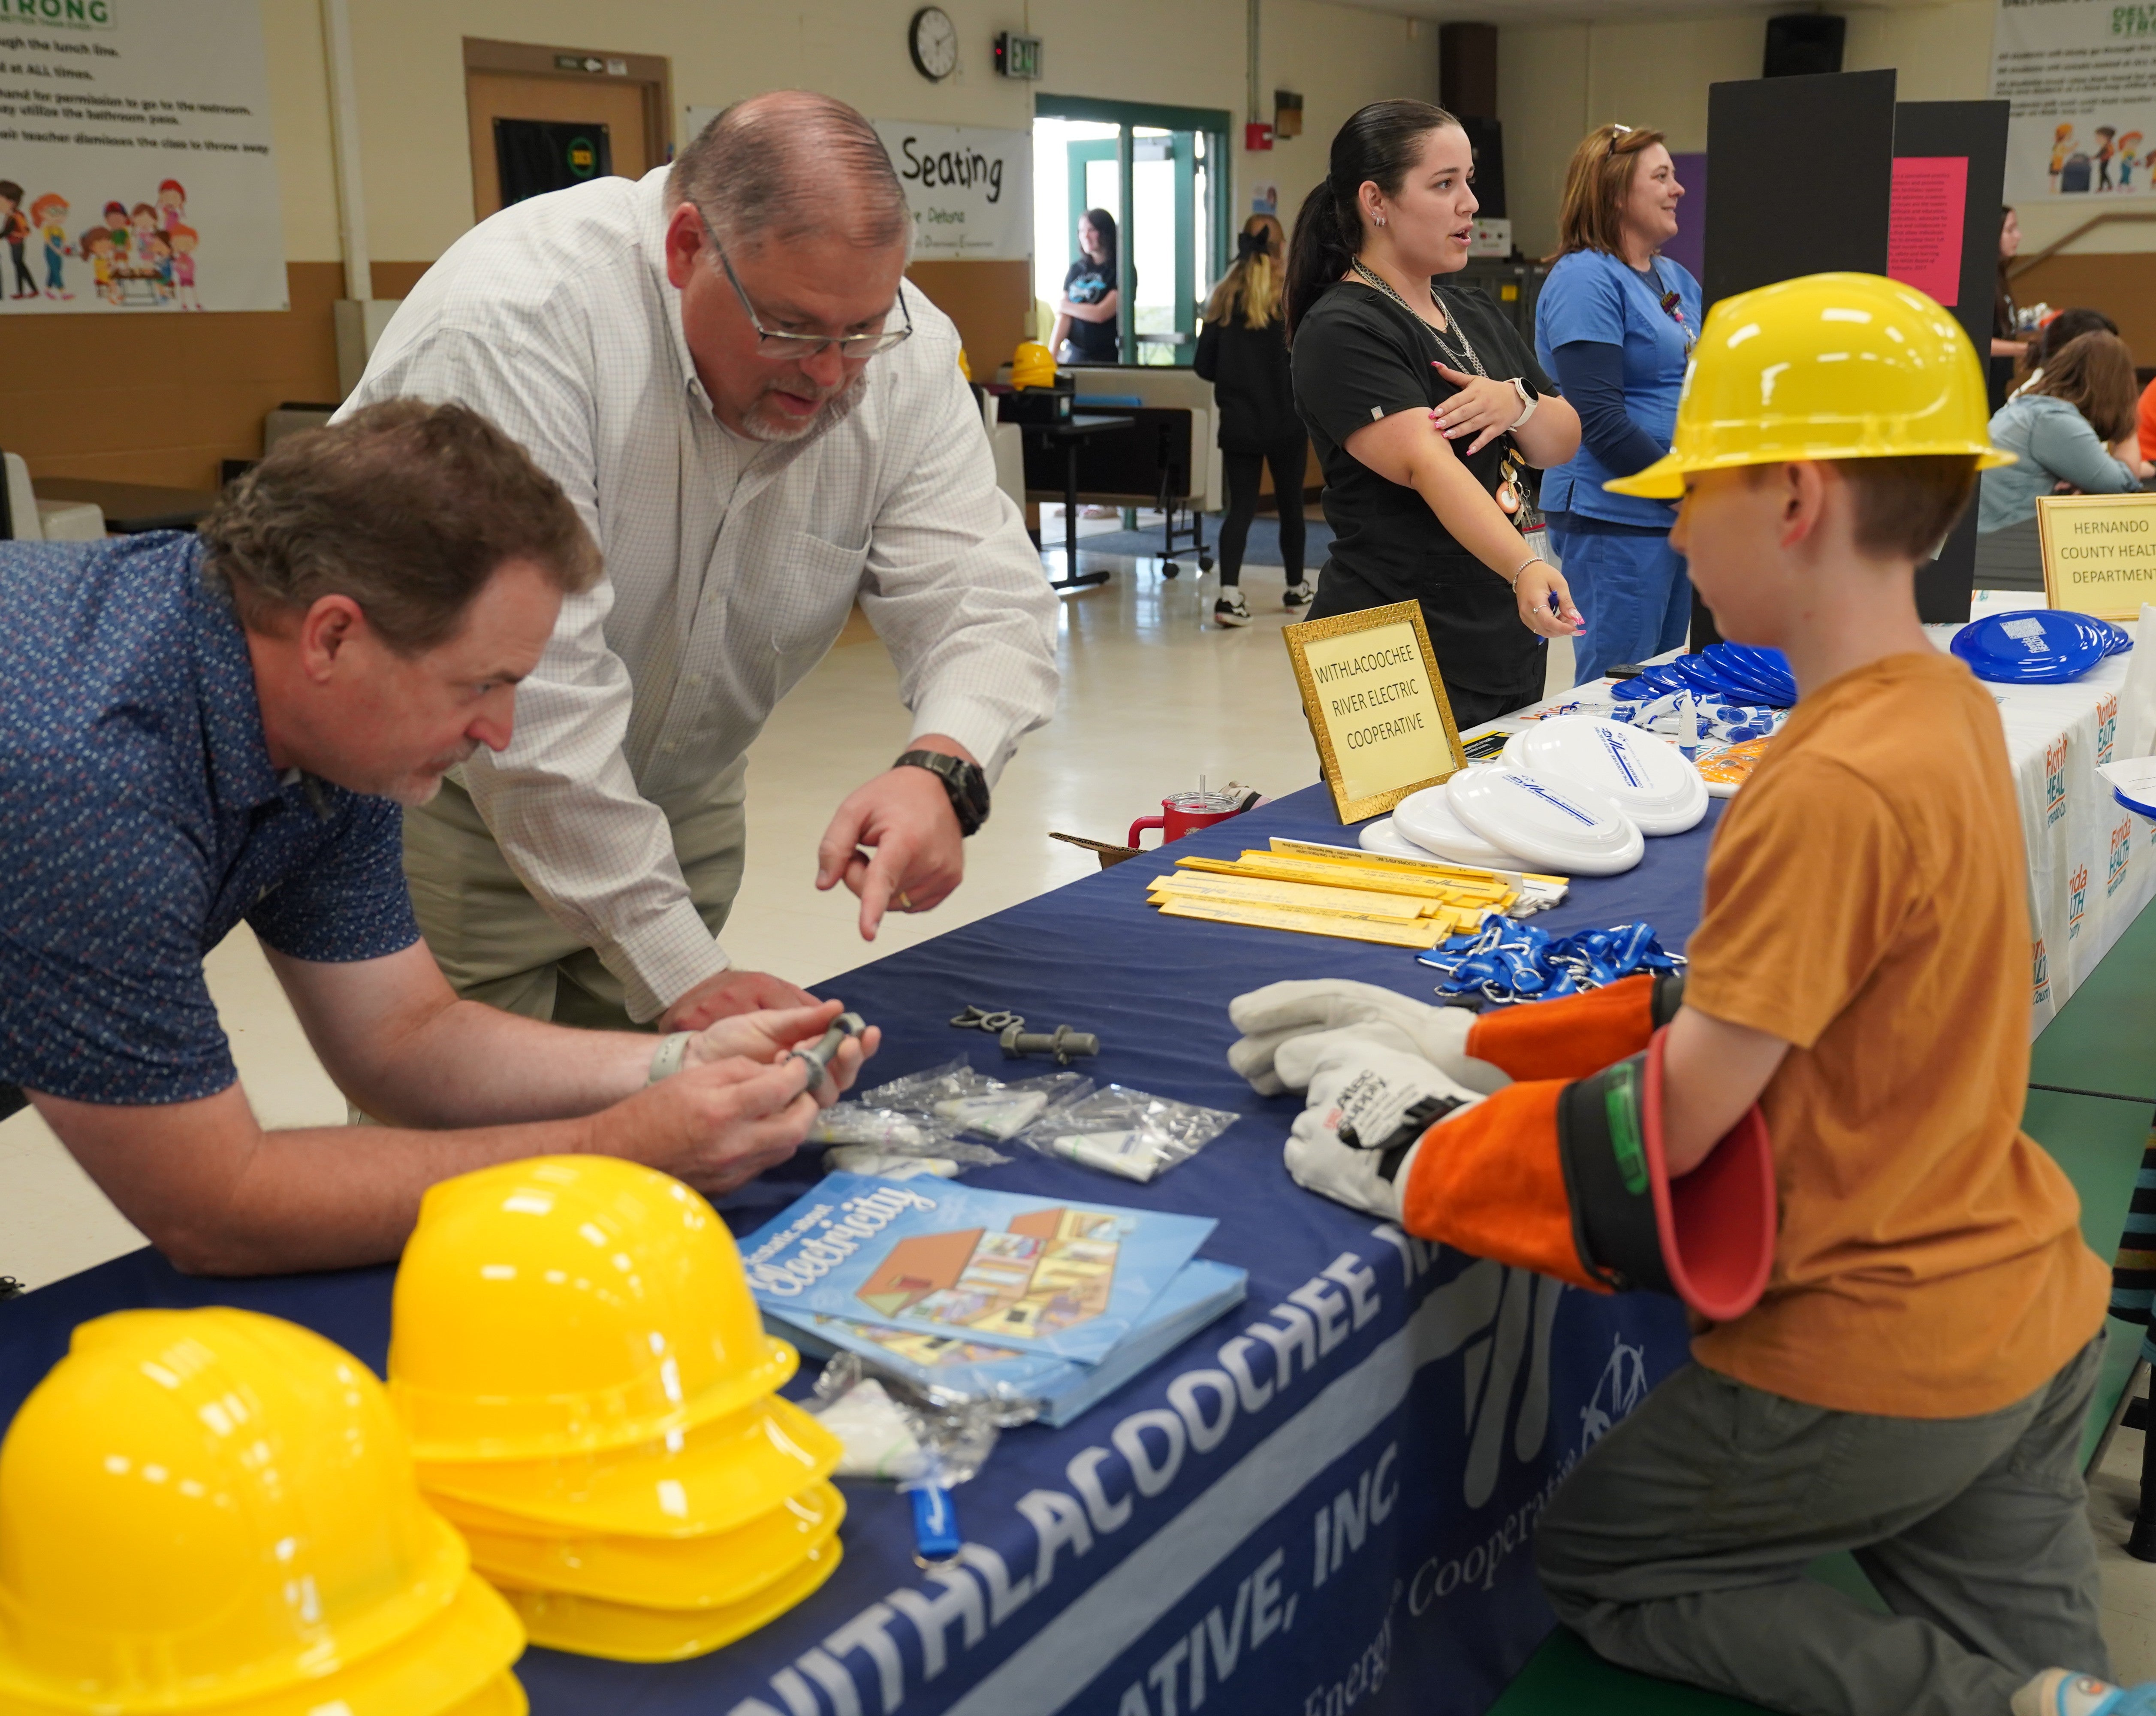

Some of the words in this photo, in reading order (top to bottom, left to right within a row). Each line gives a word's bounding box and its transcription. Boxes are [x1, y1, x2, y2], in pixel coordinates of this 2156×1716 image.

[27, 37, 50, 50] the
[52, 39, 89, 54] lunch
[1012, 38, 1040, 74] EXIT
[26, 63, 52, 77] ALL
[33, 88, 52, 102] for
[54, 93, 124, 107] permission
[125, 98, 139, 108] to
[140, 100, 157, 112] go
[160, 100, 173, 110] to
[176, 100, 195, 112] the
[62, 107, 83, 119] the
[86, 109, 146, 122] bathroom
[21, 130, 70, 143] teacher
[137, 136, 158, 148] the
[189, 139, 202, 150] to
[902, 136, 1003, 203] Seating
[2074, 520, 2149, 535] HERNANDO
[2061, 545, 2114, 559] COUNTY
[1315, 644, 1414, 684] WITHLACOOCHEE
[1332, 693, 1367, 717] RIVER
[1368, 678, 1419, 707] ELECTRIC
[1347, 713, 1425, 749] COOPERATIVE
[1337, 1069, 1375, 1111] Altec
[744, 1186, 938, 1296] Electricity
[1313, 1441, 1398, 1589] INC
